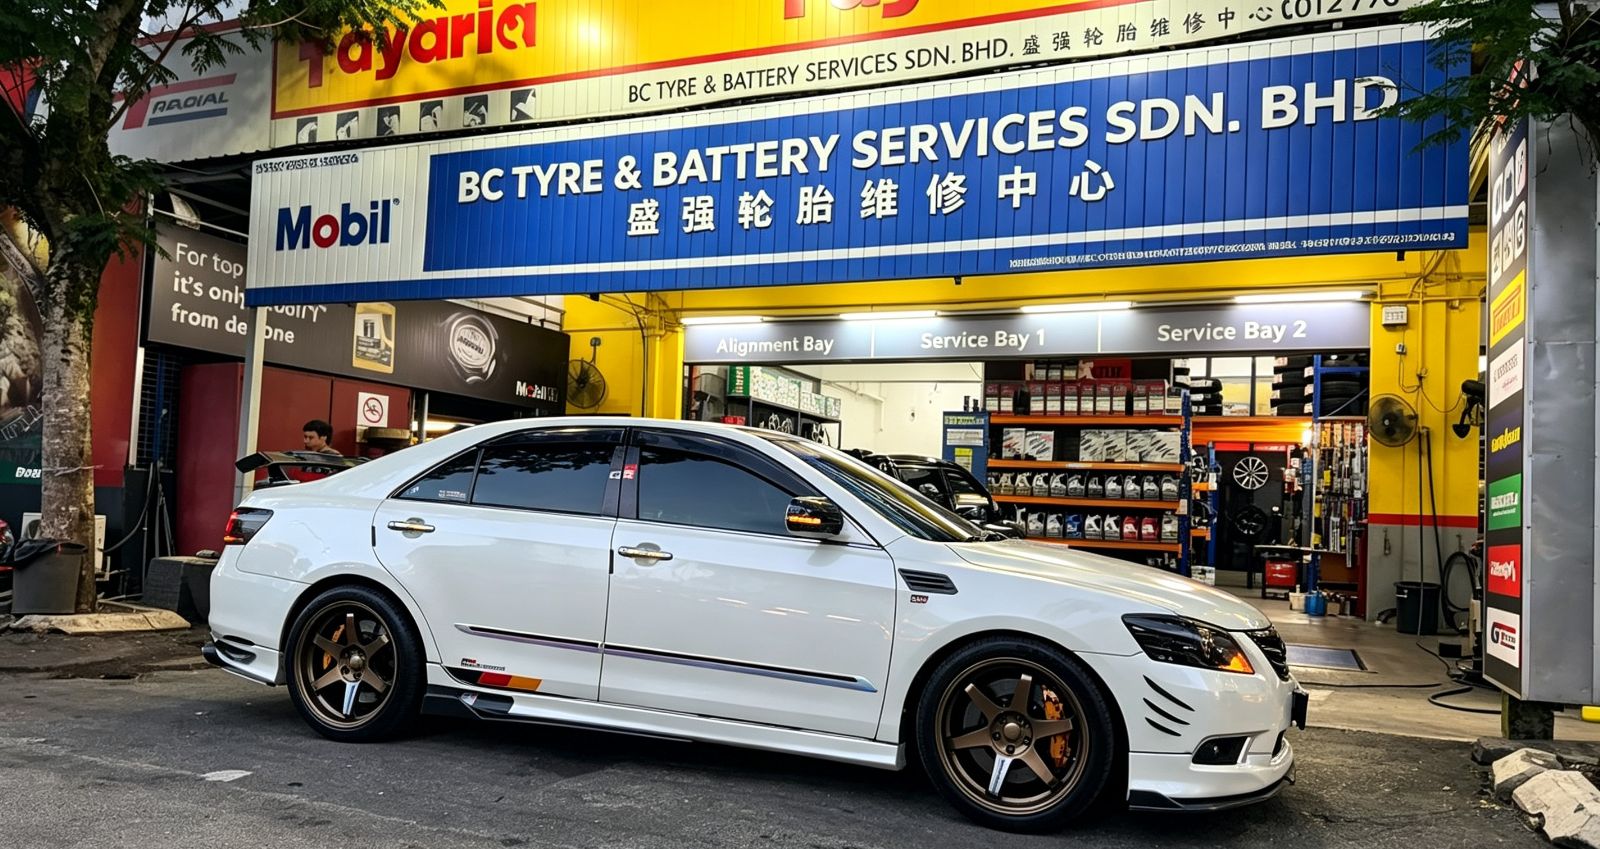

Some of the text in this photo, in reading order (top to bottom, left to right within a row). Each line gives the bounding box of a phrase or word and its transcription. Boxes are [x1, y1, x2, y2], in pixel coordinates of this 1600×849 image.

[629, 38, 1014, 102] BC TYRE & BATTERY SERVICES SDN. BHD.
[458, 168, 503, 203] BC
[511, 159, 604, 198] TYRE
[613, 155, 642, 190] &
[653, 134, 840, 187] BATTERY
[851, 106, 1089, 169] SERVICES
[1105, 92, 1240, 145] SDN.
[626, 160, 1115, 237] 盛强轮胎维修中心
[276, 199, 391, 251] Mobil
[176, 242, 244, 279] For top
[173, 270, 203, 297] it's
[171, 303, 218, 329] from
[1157, 320, 1307, 343] Service Bay 2
[717, 336, 834, 357] Alignment Bay
[920, 329, 1046, 350] Service Bay 1
